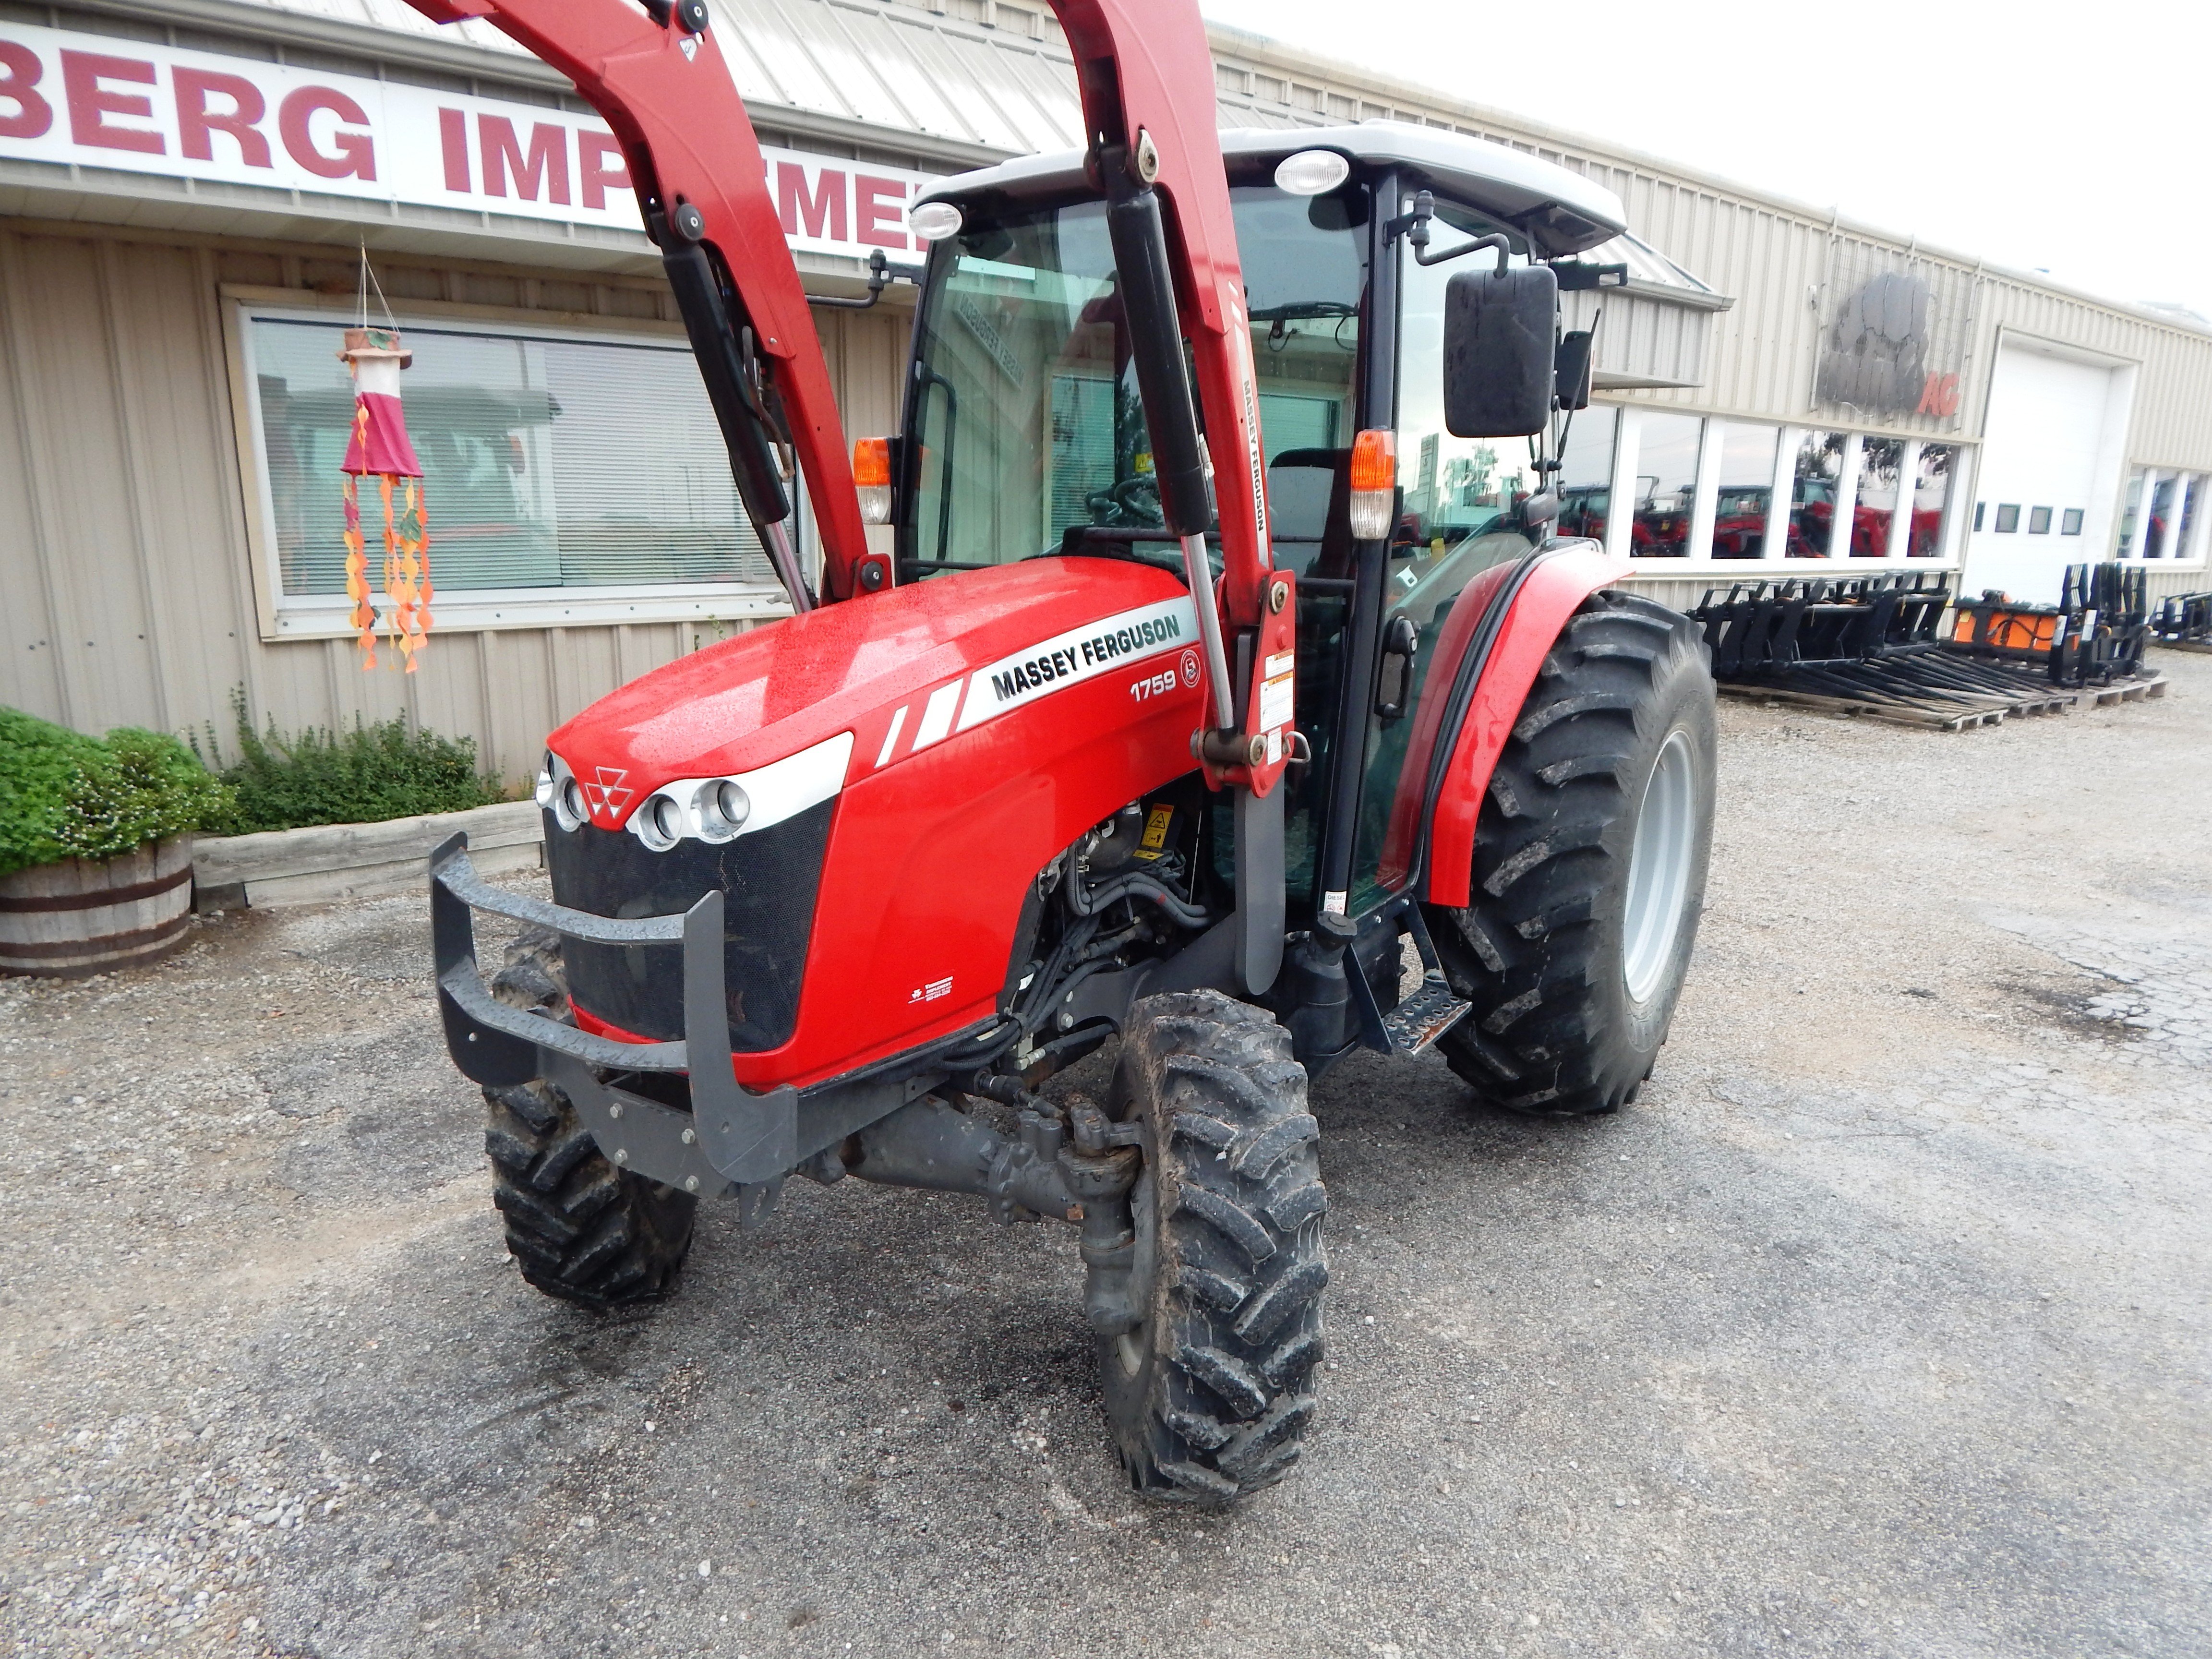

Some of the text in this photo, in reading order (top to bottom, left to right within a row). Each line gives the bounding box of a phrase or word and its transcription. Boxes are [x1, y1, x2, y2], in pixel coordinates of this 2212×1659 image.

[1916, 370, 1960, 417] AG
[1244, 380, 1264, 532] MASSEY FERGUSON
[991, 614, 1181, 701] MASSEY FERGUSON
[1130, 670, 1177, 702] 1759
